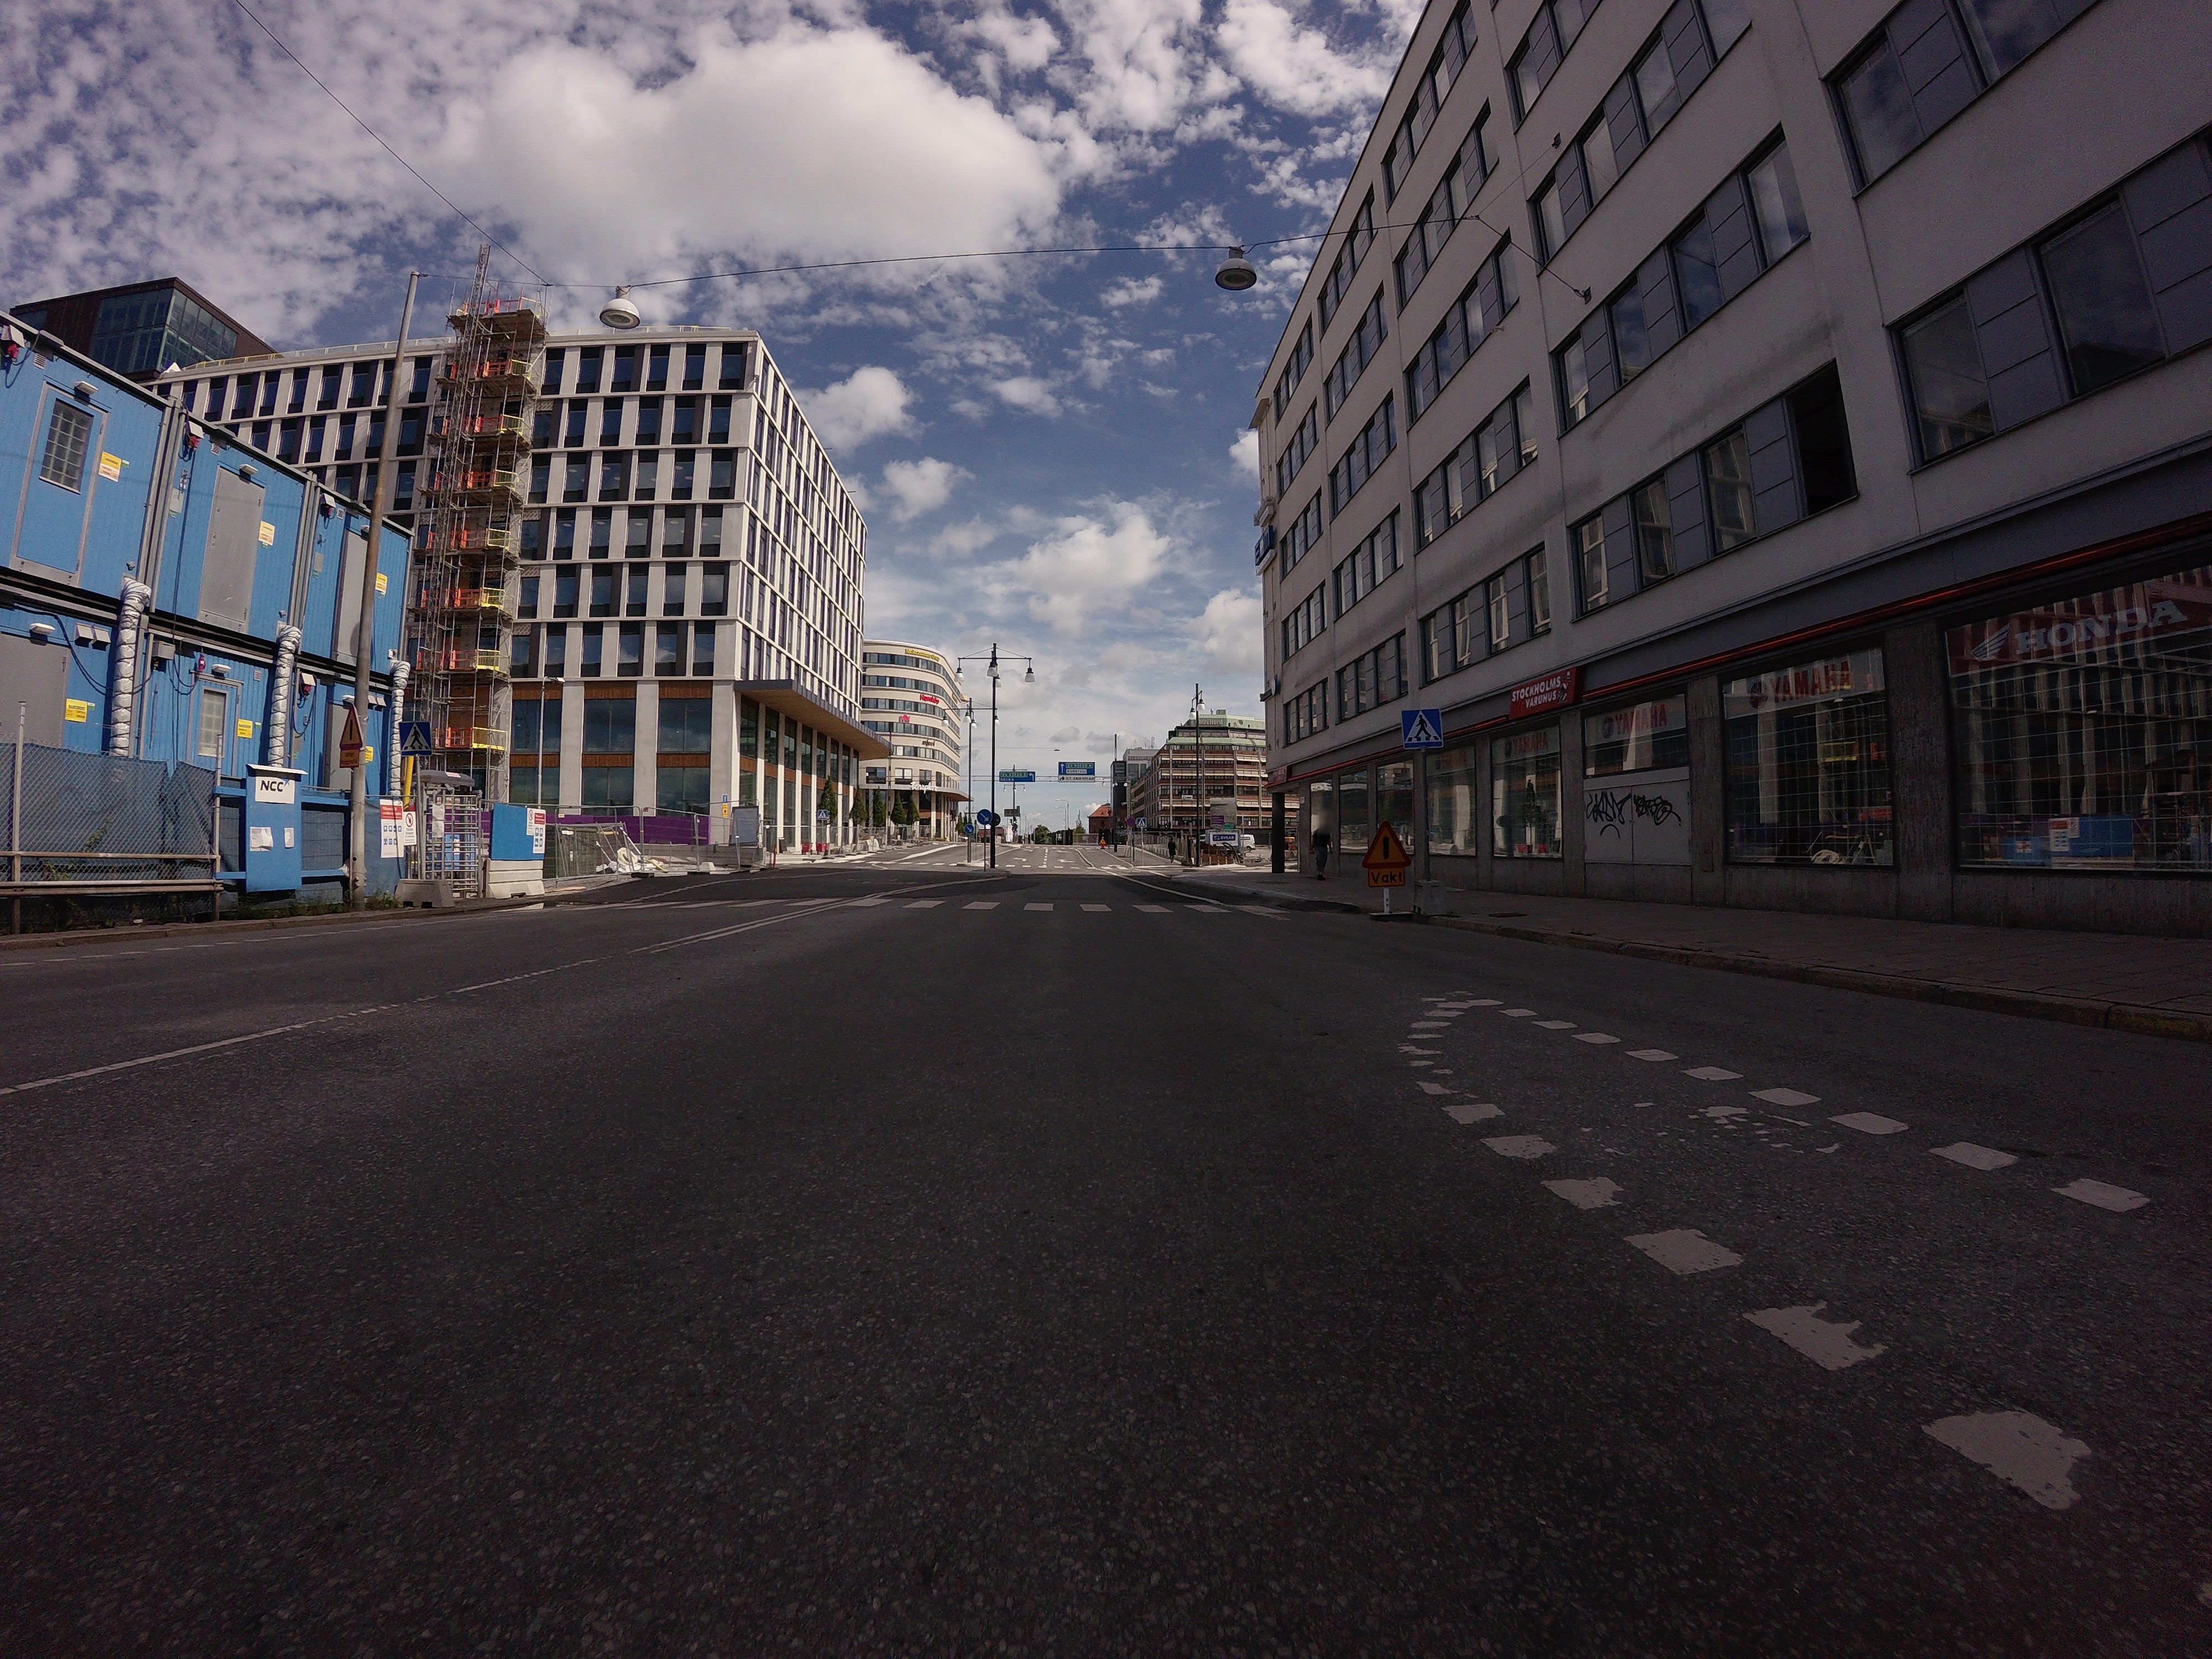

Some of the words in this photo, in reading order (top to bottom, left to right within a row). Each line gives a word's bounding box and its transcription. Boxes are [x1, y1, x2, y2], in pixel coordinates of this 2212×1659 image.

[2015, 600, 2188, 655] HONDA
[1511, 676, 1561, 702] STOCKHOLMS
[1771, 661, 1853, 703] YAMAHA
[1525, 690, 1557, 708] VARUHUS
[1615, 703, 1667, 735] YAMAHA
[1513, 732, 1549, 754] YAMAHA
[260, 780, 284, 792] NCC
[1371, 872, 1402, 883] Vakt
